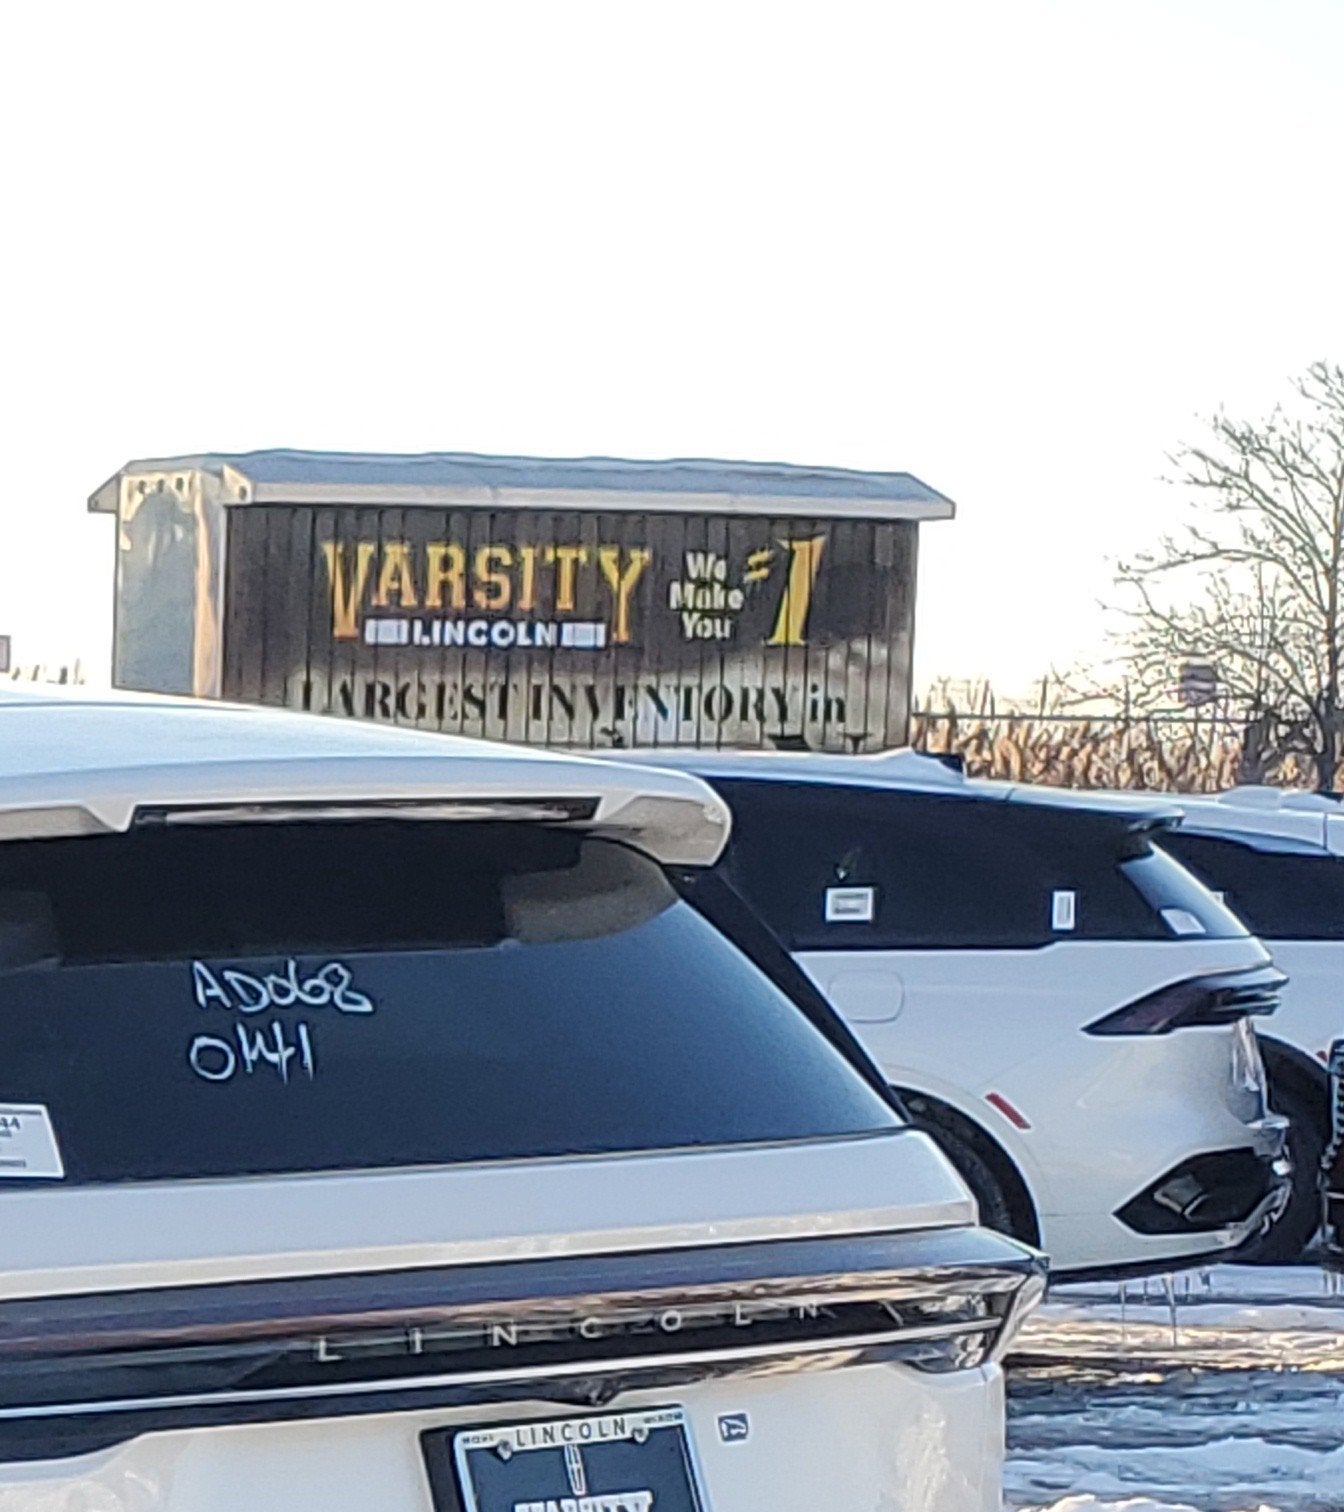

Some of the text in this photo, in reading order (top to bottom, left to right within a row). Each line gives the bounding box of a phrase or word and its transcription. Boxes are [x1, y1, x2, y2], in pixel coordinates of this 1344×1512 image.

[684, 552, 728, 580] We
[322, 539, 652, 642] VARSITY
[669, 579, 745, 611] Make
[411, 618, 559, 648] LINCOLN
[681, 611, 733, 640] You
[810, 682, 846, 724] in
[317, 1302, 824, 1362] LINCOLN
[515, 1416, 627, 1447] LINCOLN
